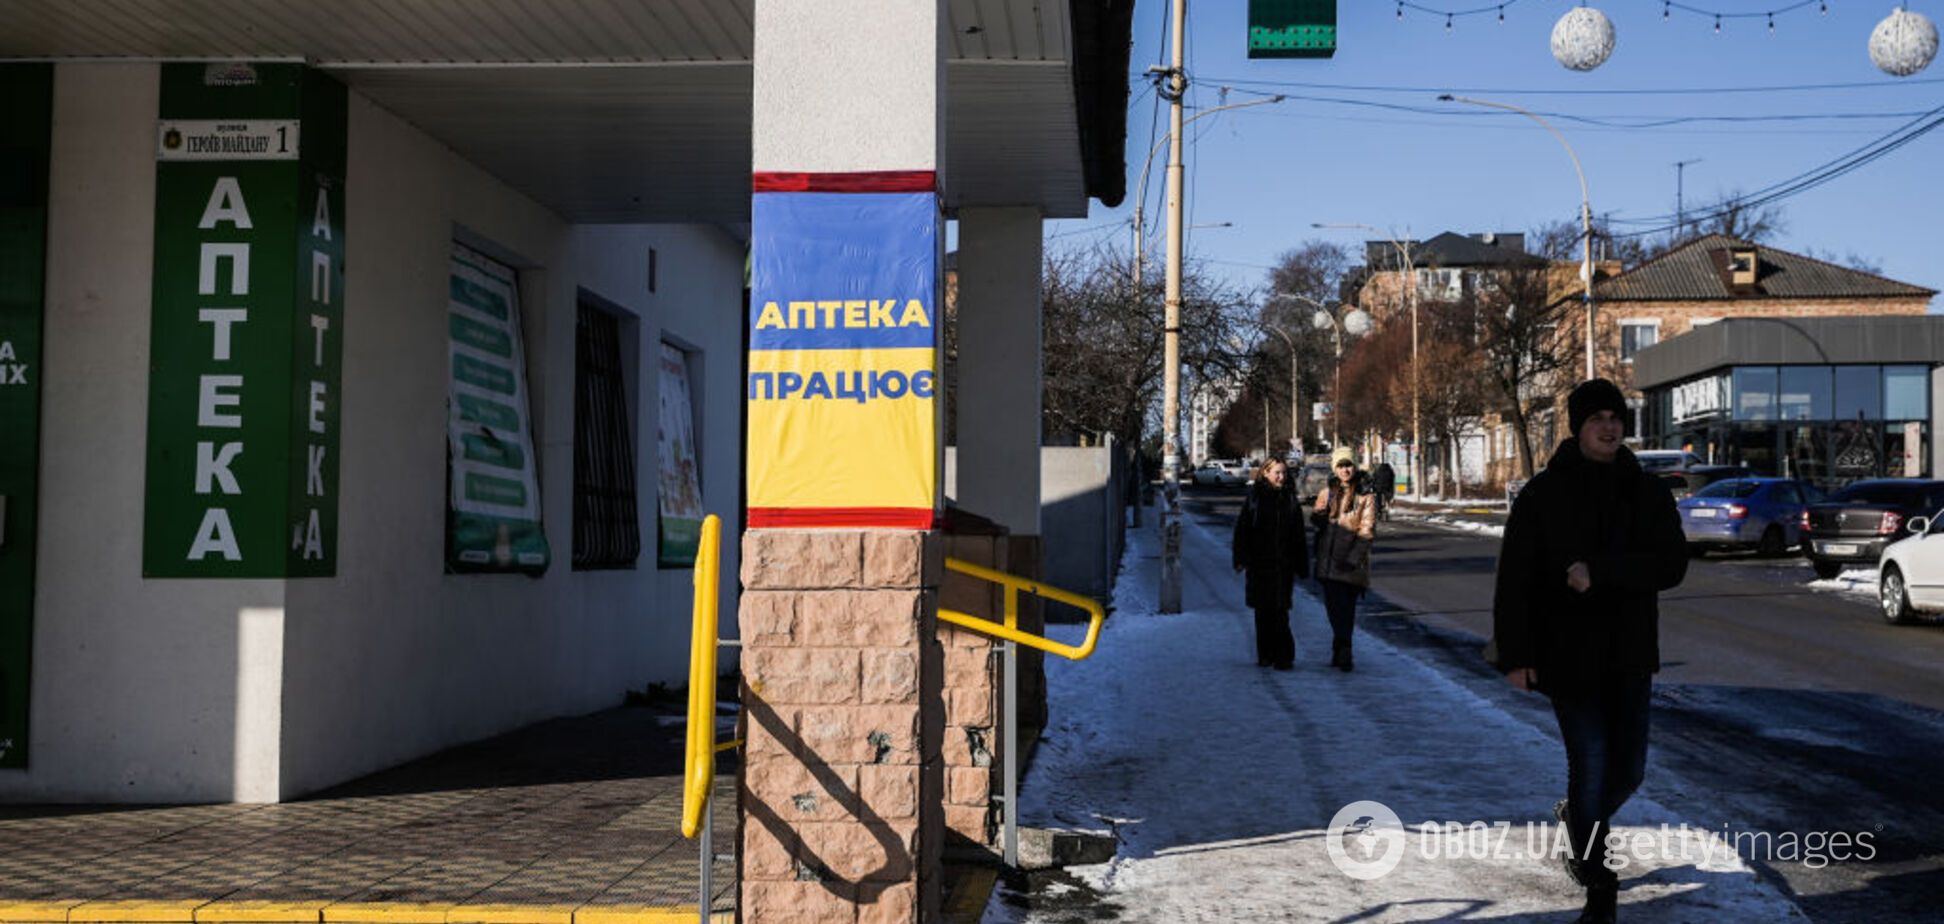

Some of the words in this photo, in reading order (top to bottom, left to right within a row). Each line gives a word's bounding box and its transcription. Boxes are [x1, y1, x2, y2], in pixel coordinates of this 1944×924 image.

[277, 126, 289, 153] 1
[755, 299, 931, 330] АПТЕКА
[187, 176, 253, 561] АПТЕКА
[303, 188, 332, 560] АПТЕКА
[750, 370, 935, 404] ПРАЦЮЄ
